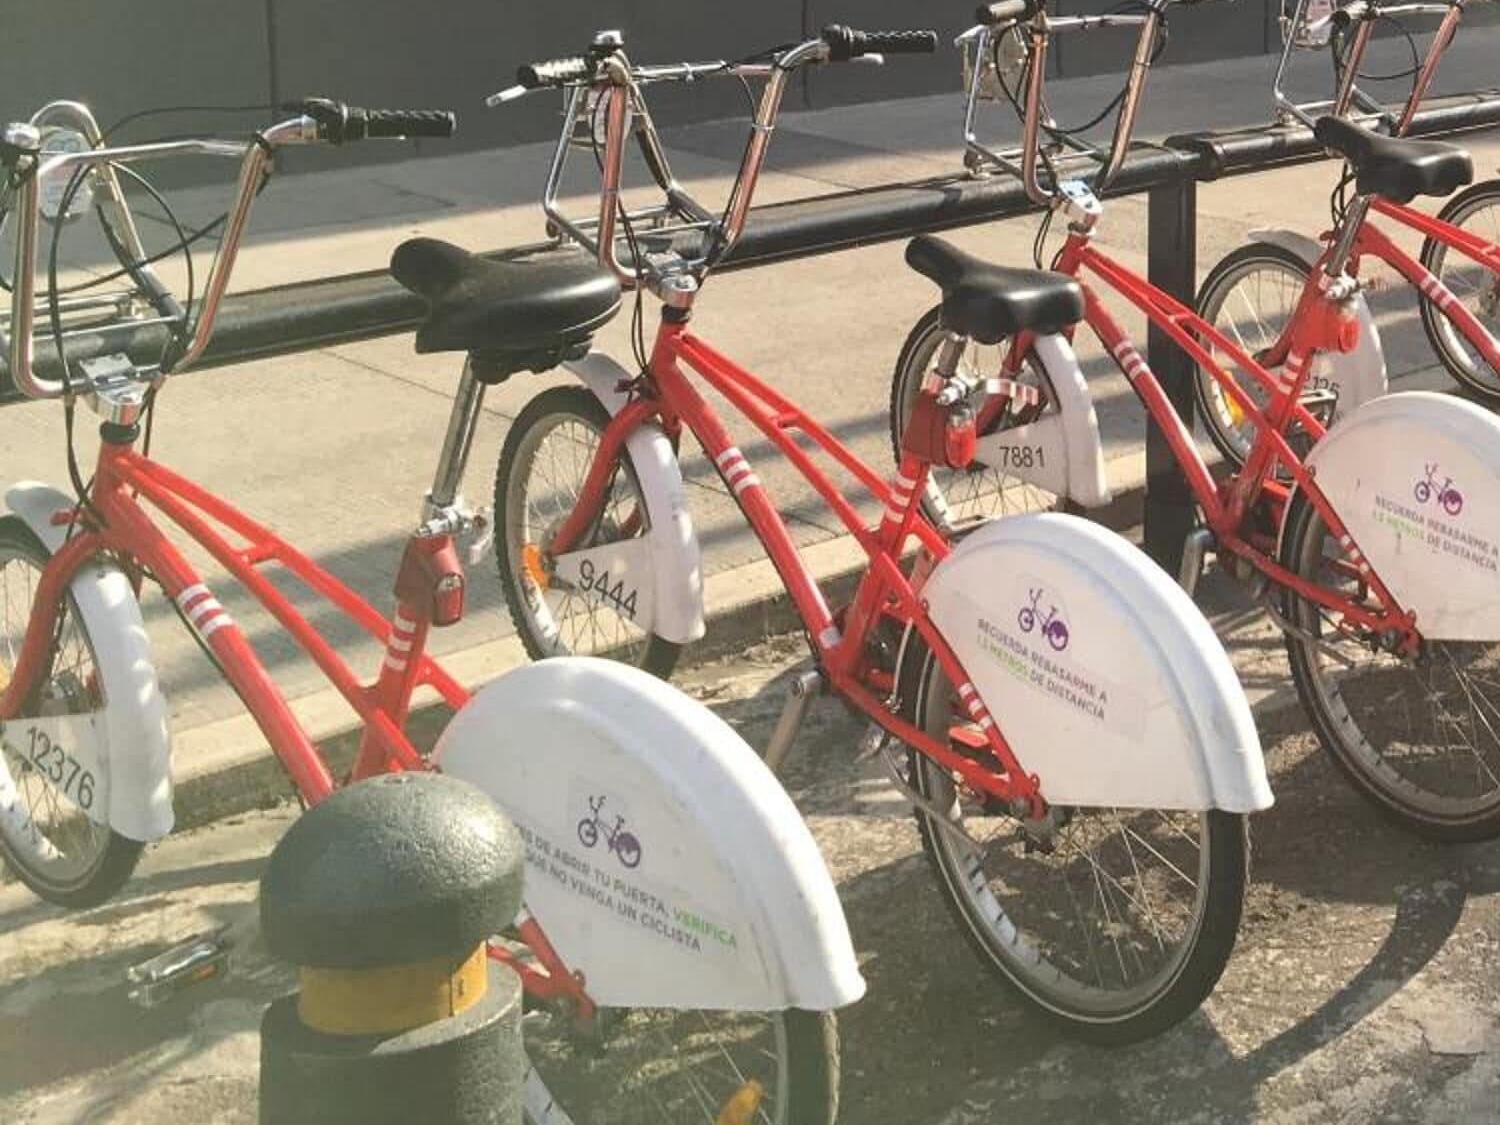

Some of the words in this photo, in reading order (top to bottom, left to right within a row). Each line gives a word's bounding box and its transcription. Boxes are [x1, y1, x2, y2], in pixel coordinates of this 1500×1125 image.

[1000, 446, 1045, 468] 7881
[1427, 534, 1441, 550] DE
[580, 559, 637, 620] 9444
[1030, 669, 1045, 687] DE
[1047, 679, 1105, 721] DISTANCIA
[27, 726, 95, 810] 12376
[569, 873, 613, 911] VENGA
[617, 901, 638, 924] UN
[639, 911, 702, 953] CICLISTA
[673, 905, 738, 950] VERIFICA
